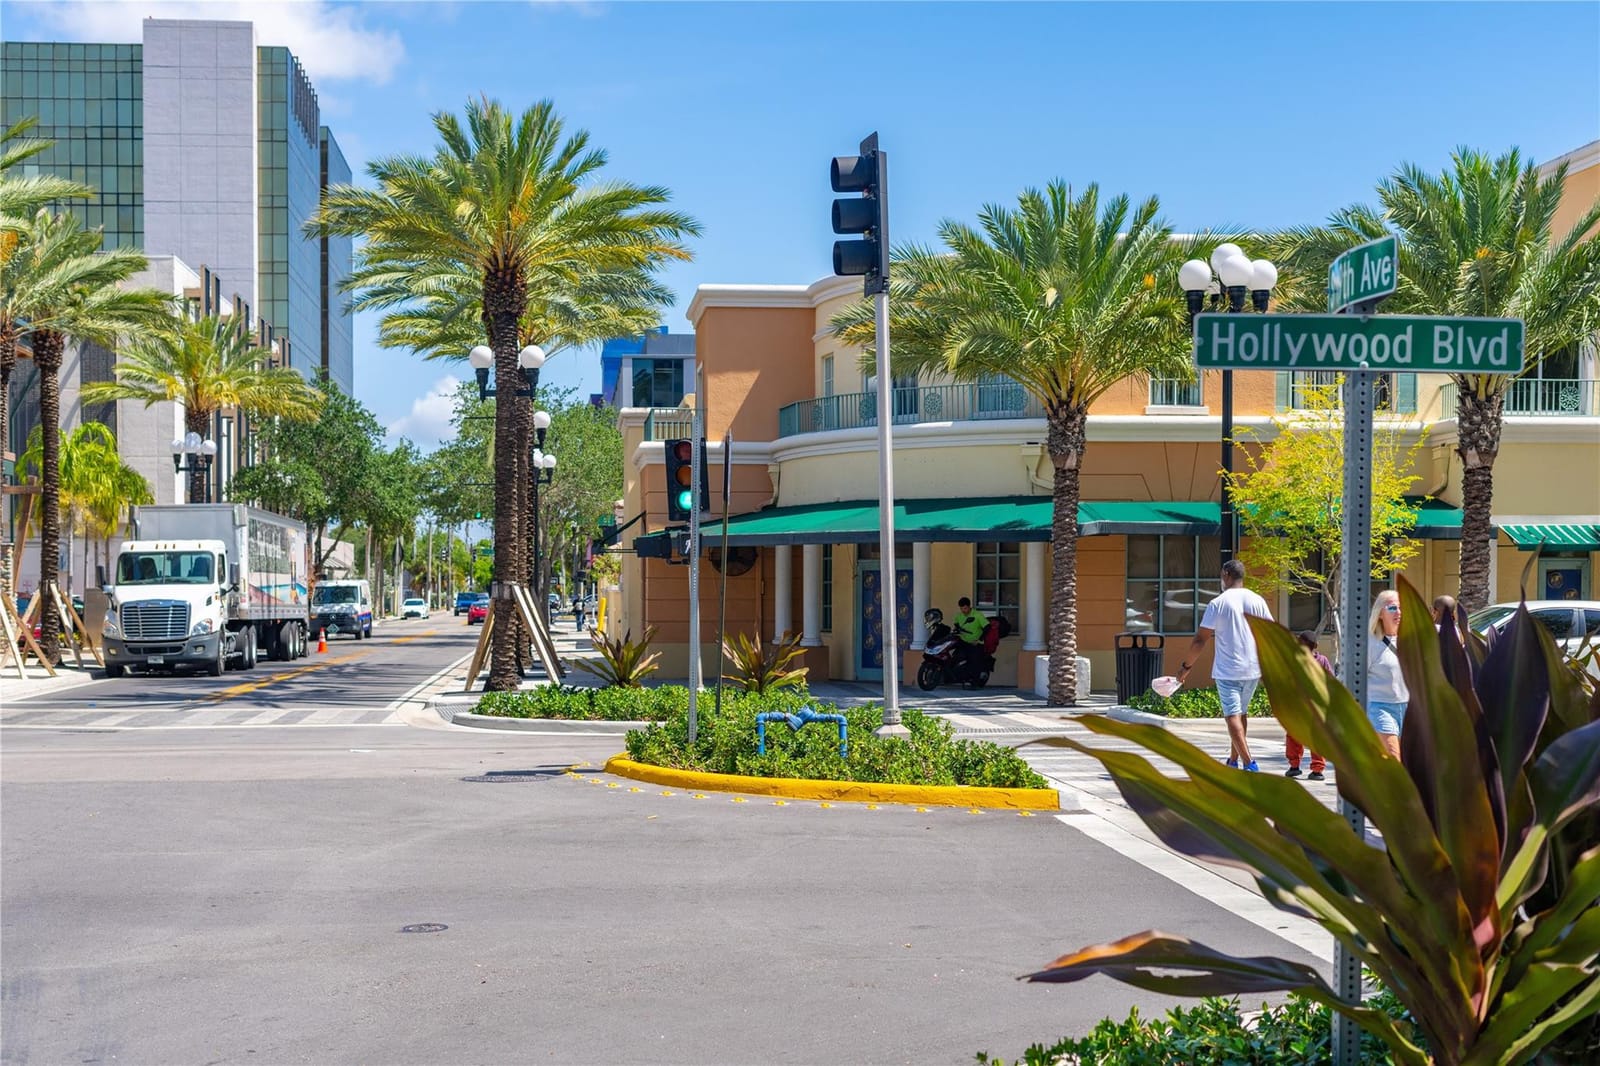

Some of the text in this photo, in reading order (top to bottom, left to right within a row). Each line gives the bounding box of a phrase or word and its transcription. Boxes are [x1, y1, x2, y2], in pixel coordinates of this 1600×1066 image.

[1360, 252, 1392, 293] Ave
[1211, 322, 1508, 366] Hollywood Blvd
